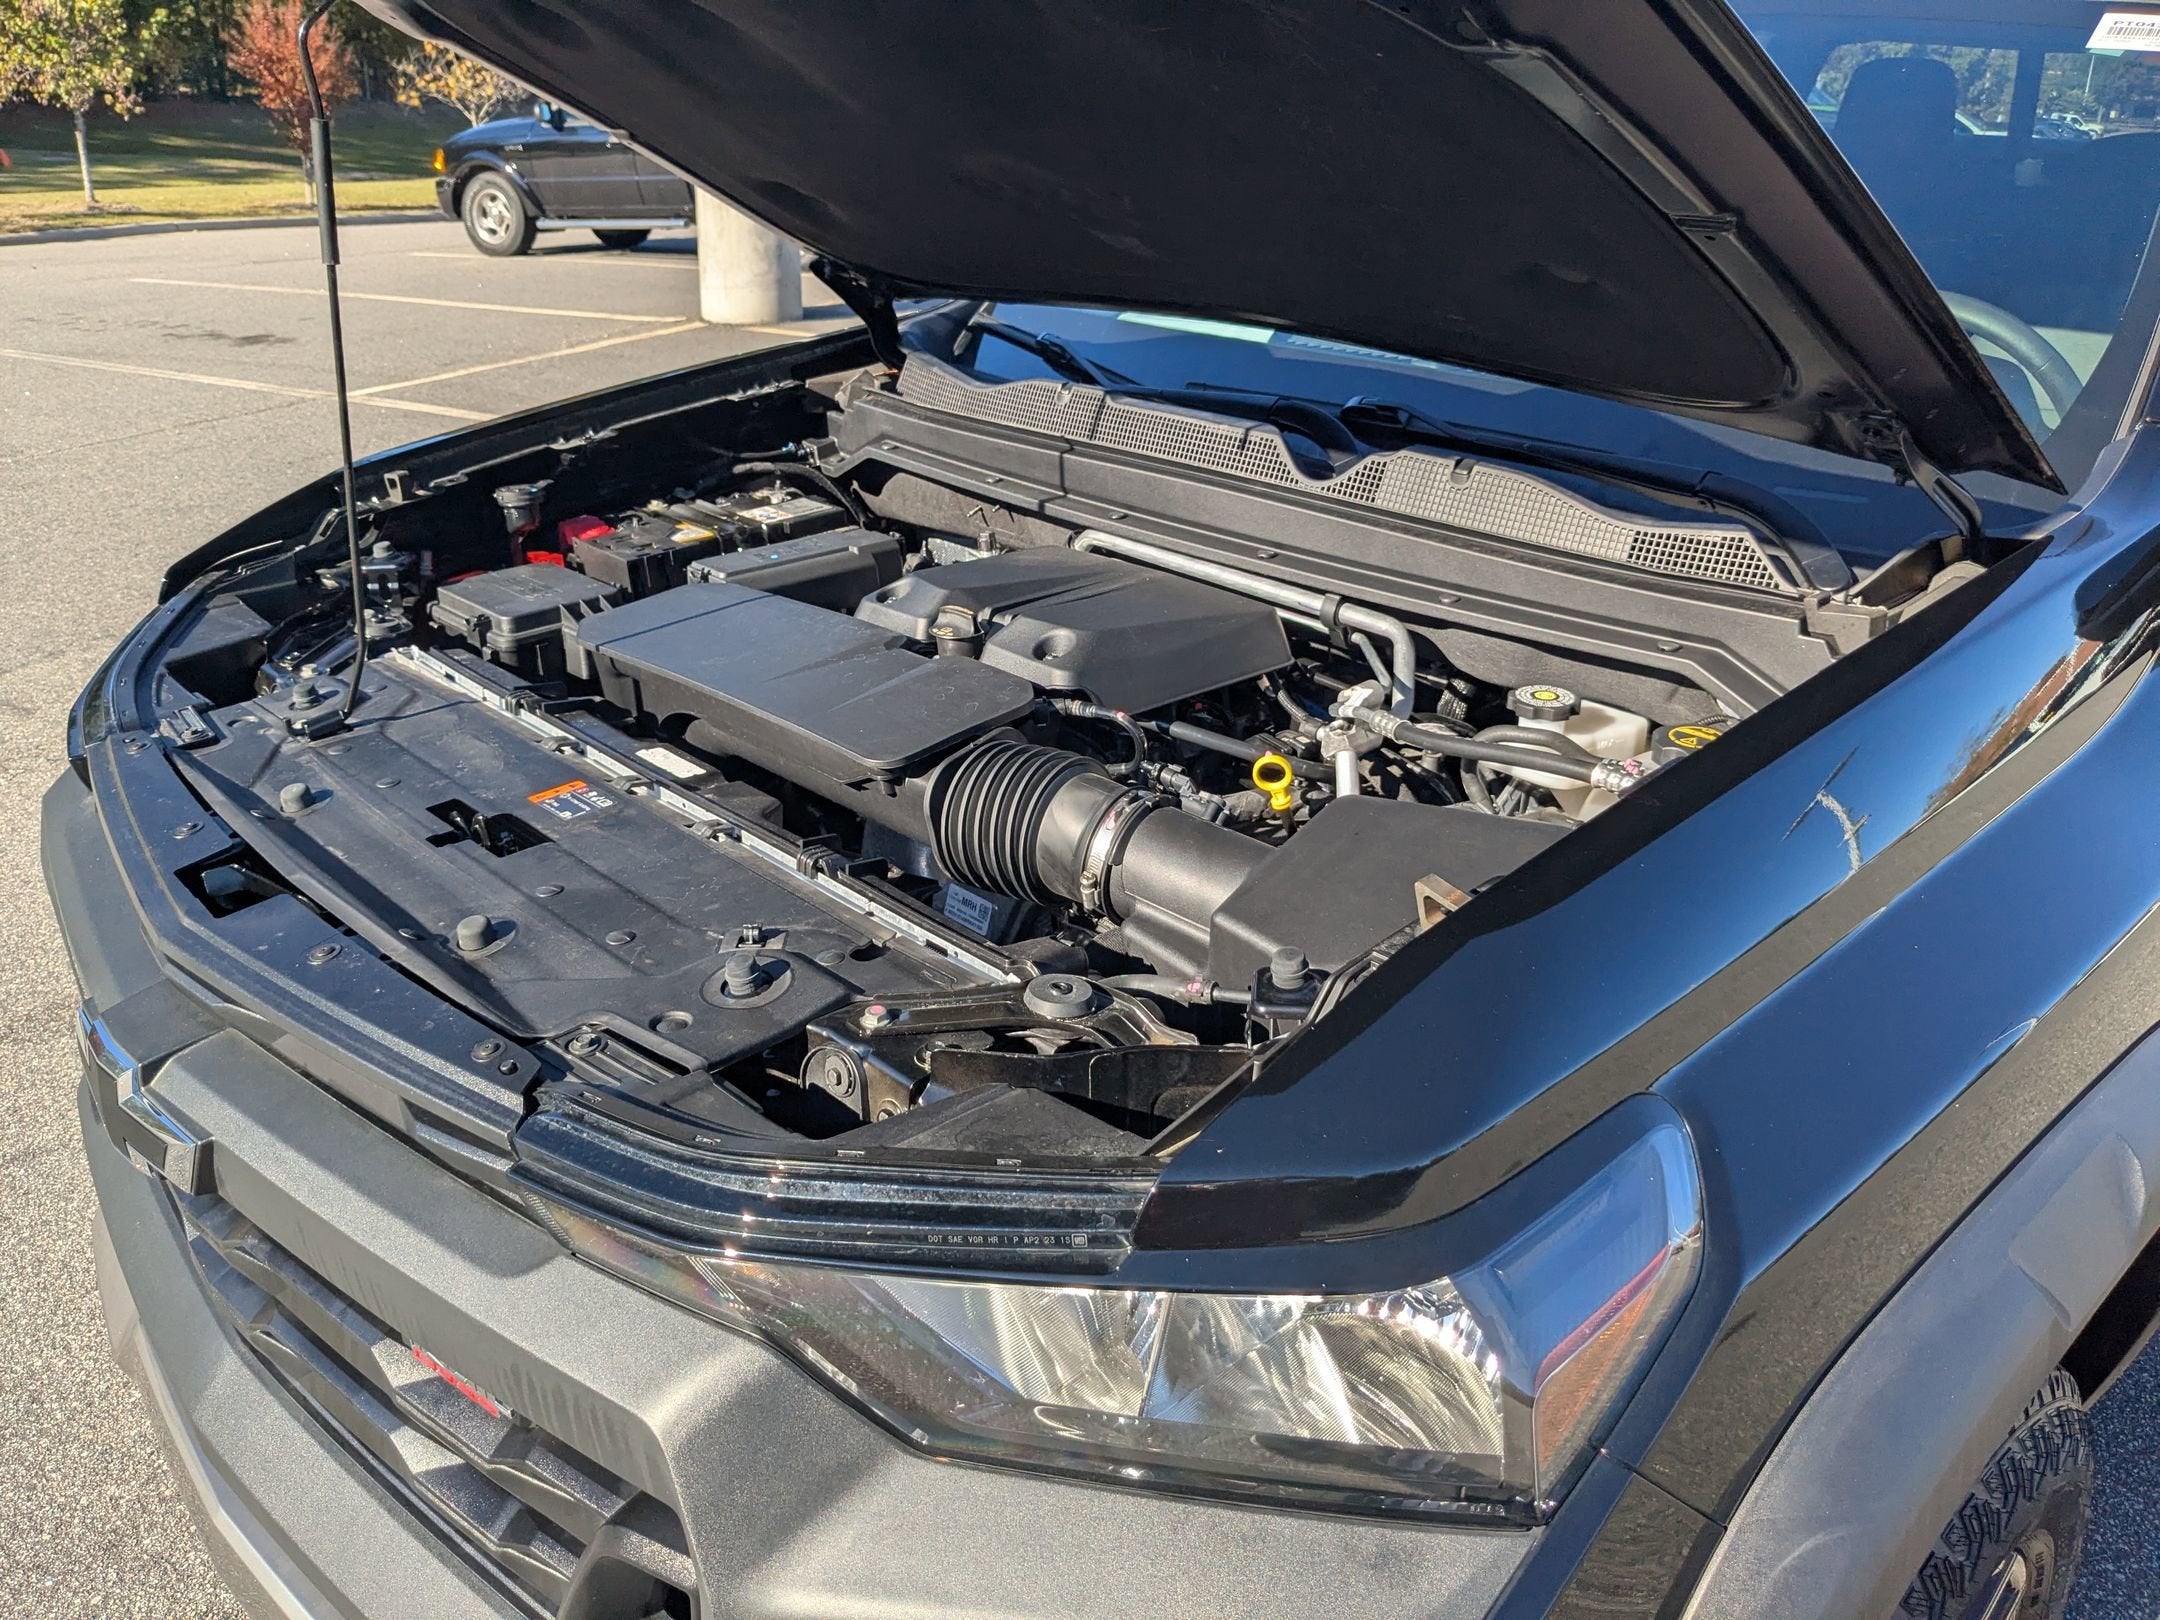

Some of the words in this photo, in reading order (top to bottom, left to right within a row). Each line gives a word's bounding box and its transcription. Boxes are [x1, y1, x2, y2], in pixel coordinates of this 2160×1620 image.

[2113, 20, 2160, 28] PT04
[928, 1235, 943, 1243] DOT
[948, 1235, 963, 1243] SAE
[968, 1235, 983, 1243] VOR
[987, 1236, 999, 1244] HR
[1013, 1236, 1019, 1244] P
[1024, 1236, 1040, 1244] AP2
[1044, 1236, 1055, 1244] 23
